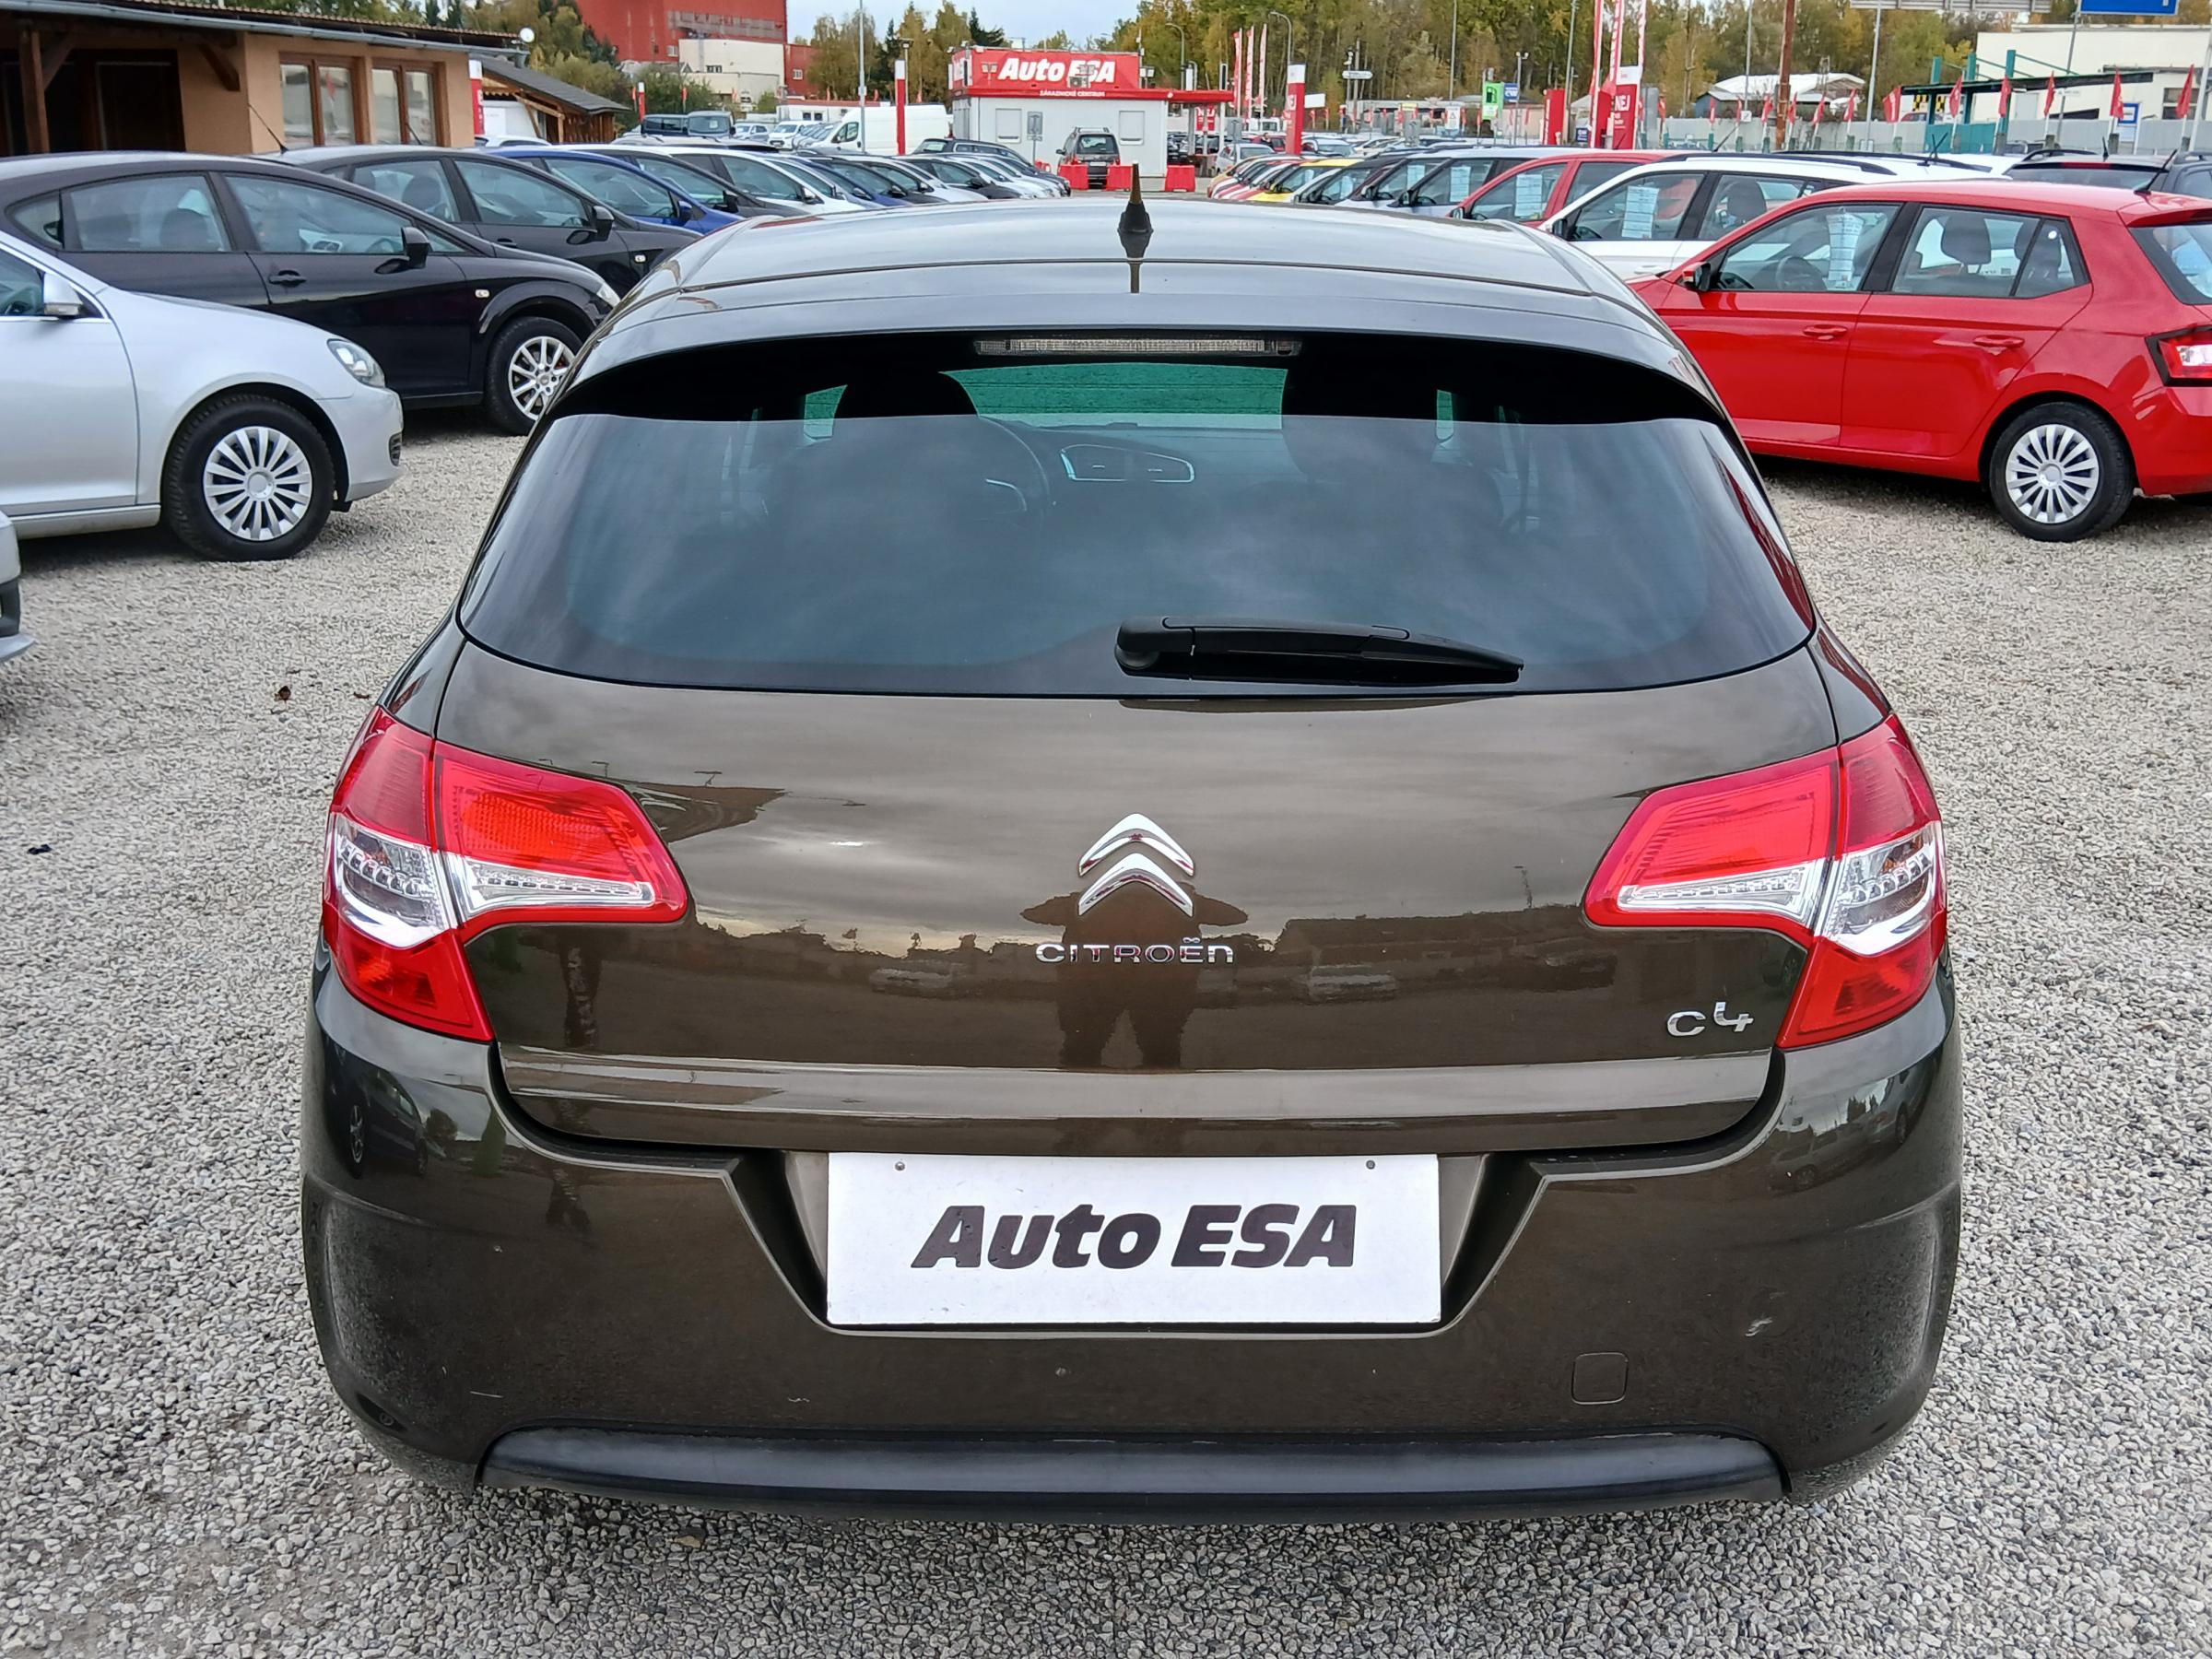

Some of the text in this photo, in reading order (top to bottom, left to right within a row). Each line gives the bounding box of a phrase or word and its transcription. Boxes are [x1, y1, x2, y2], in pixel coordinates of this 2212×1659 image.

[998, 58, 1065, 82] Auto
[1066, 60, 1116, 83] ESA
[1666, 1001, 1755, 1037] C4
[911, 1203, 1358, 1270] Auto ESA
